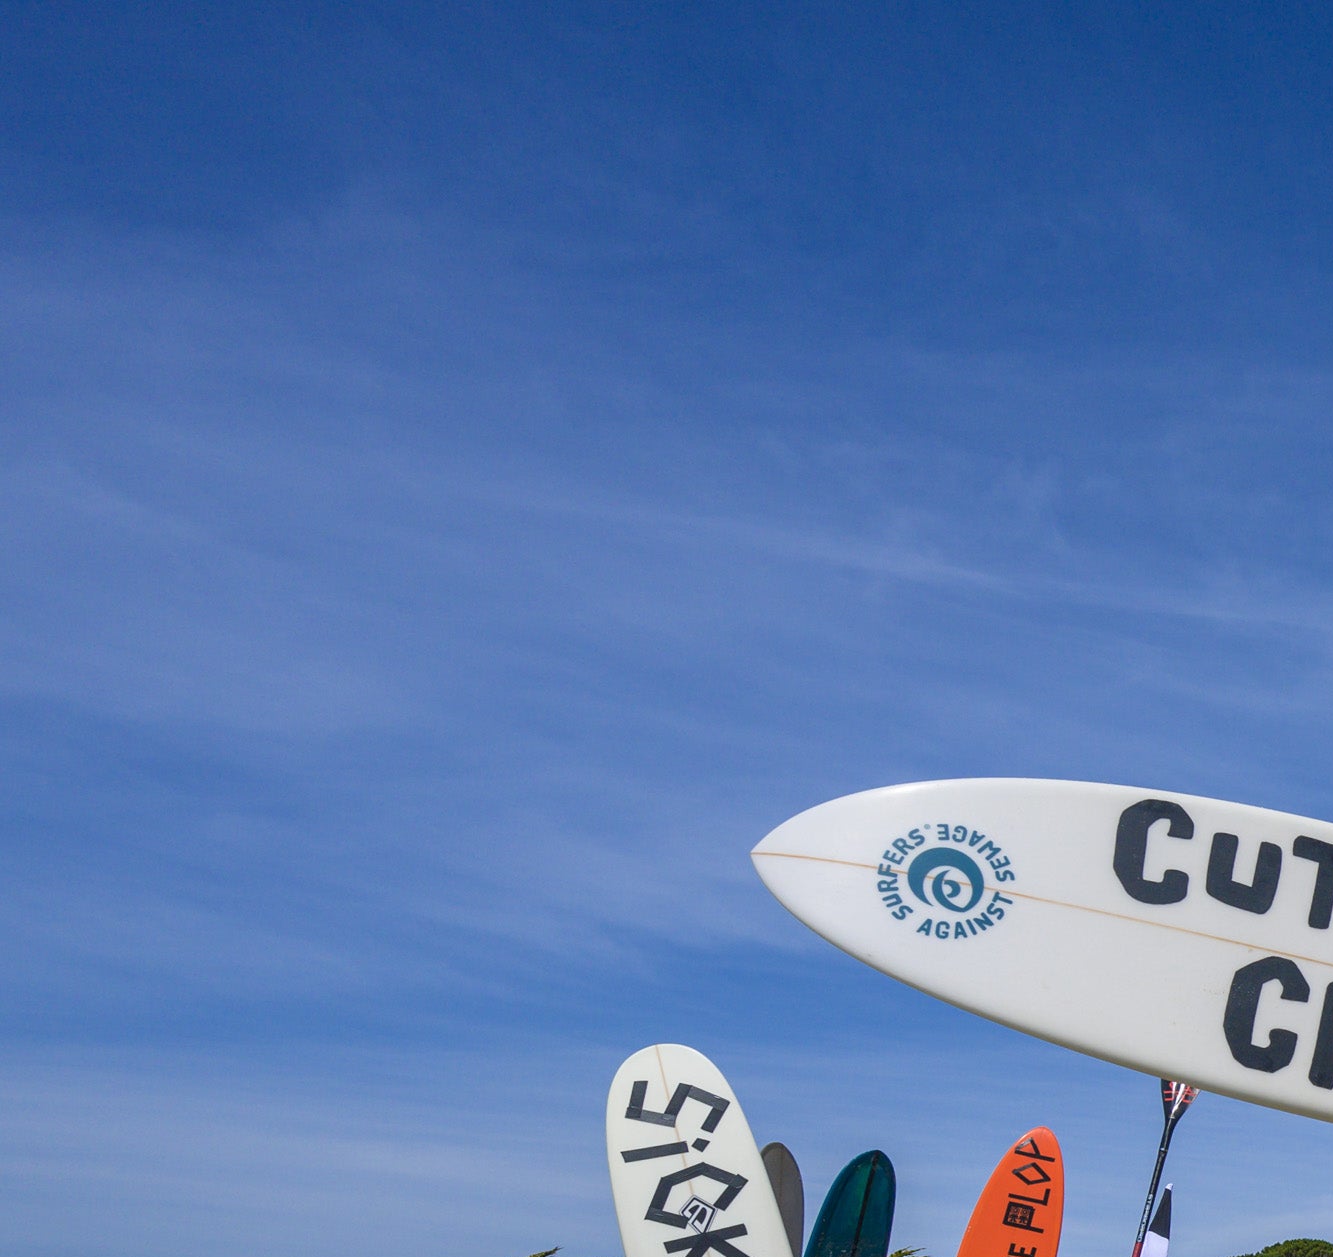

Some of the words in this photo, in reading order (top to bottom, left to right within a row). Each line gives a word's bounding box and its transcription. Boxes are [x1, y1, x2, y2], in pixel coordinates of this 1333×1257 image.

[877, 828, 925, 920] SURFERS
[937, 823, 1015, 882] SEWAGE
[916, 891, 1013, 939] AGAINST
[1003, 1137, 1055, 1233] PLOP
